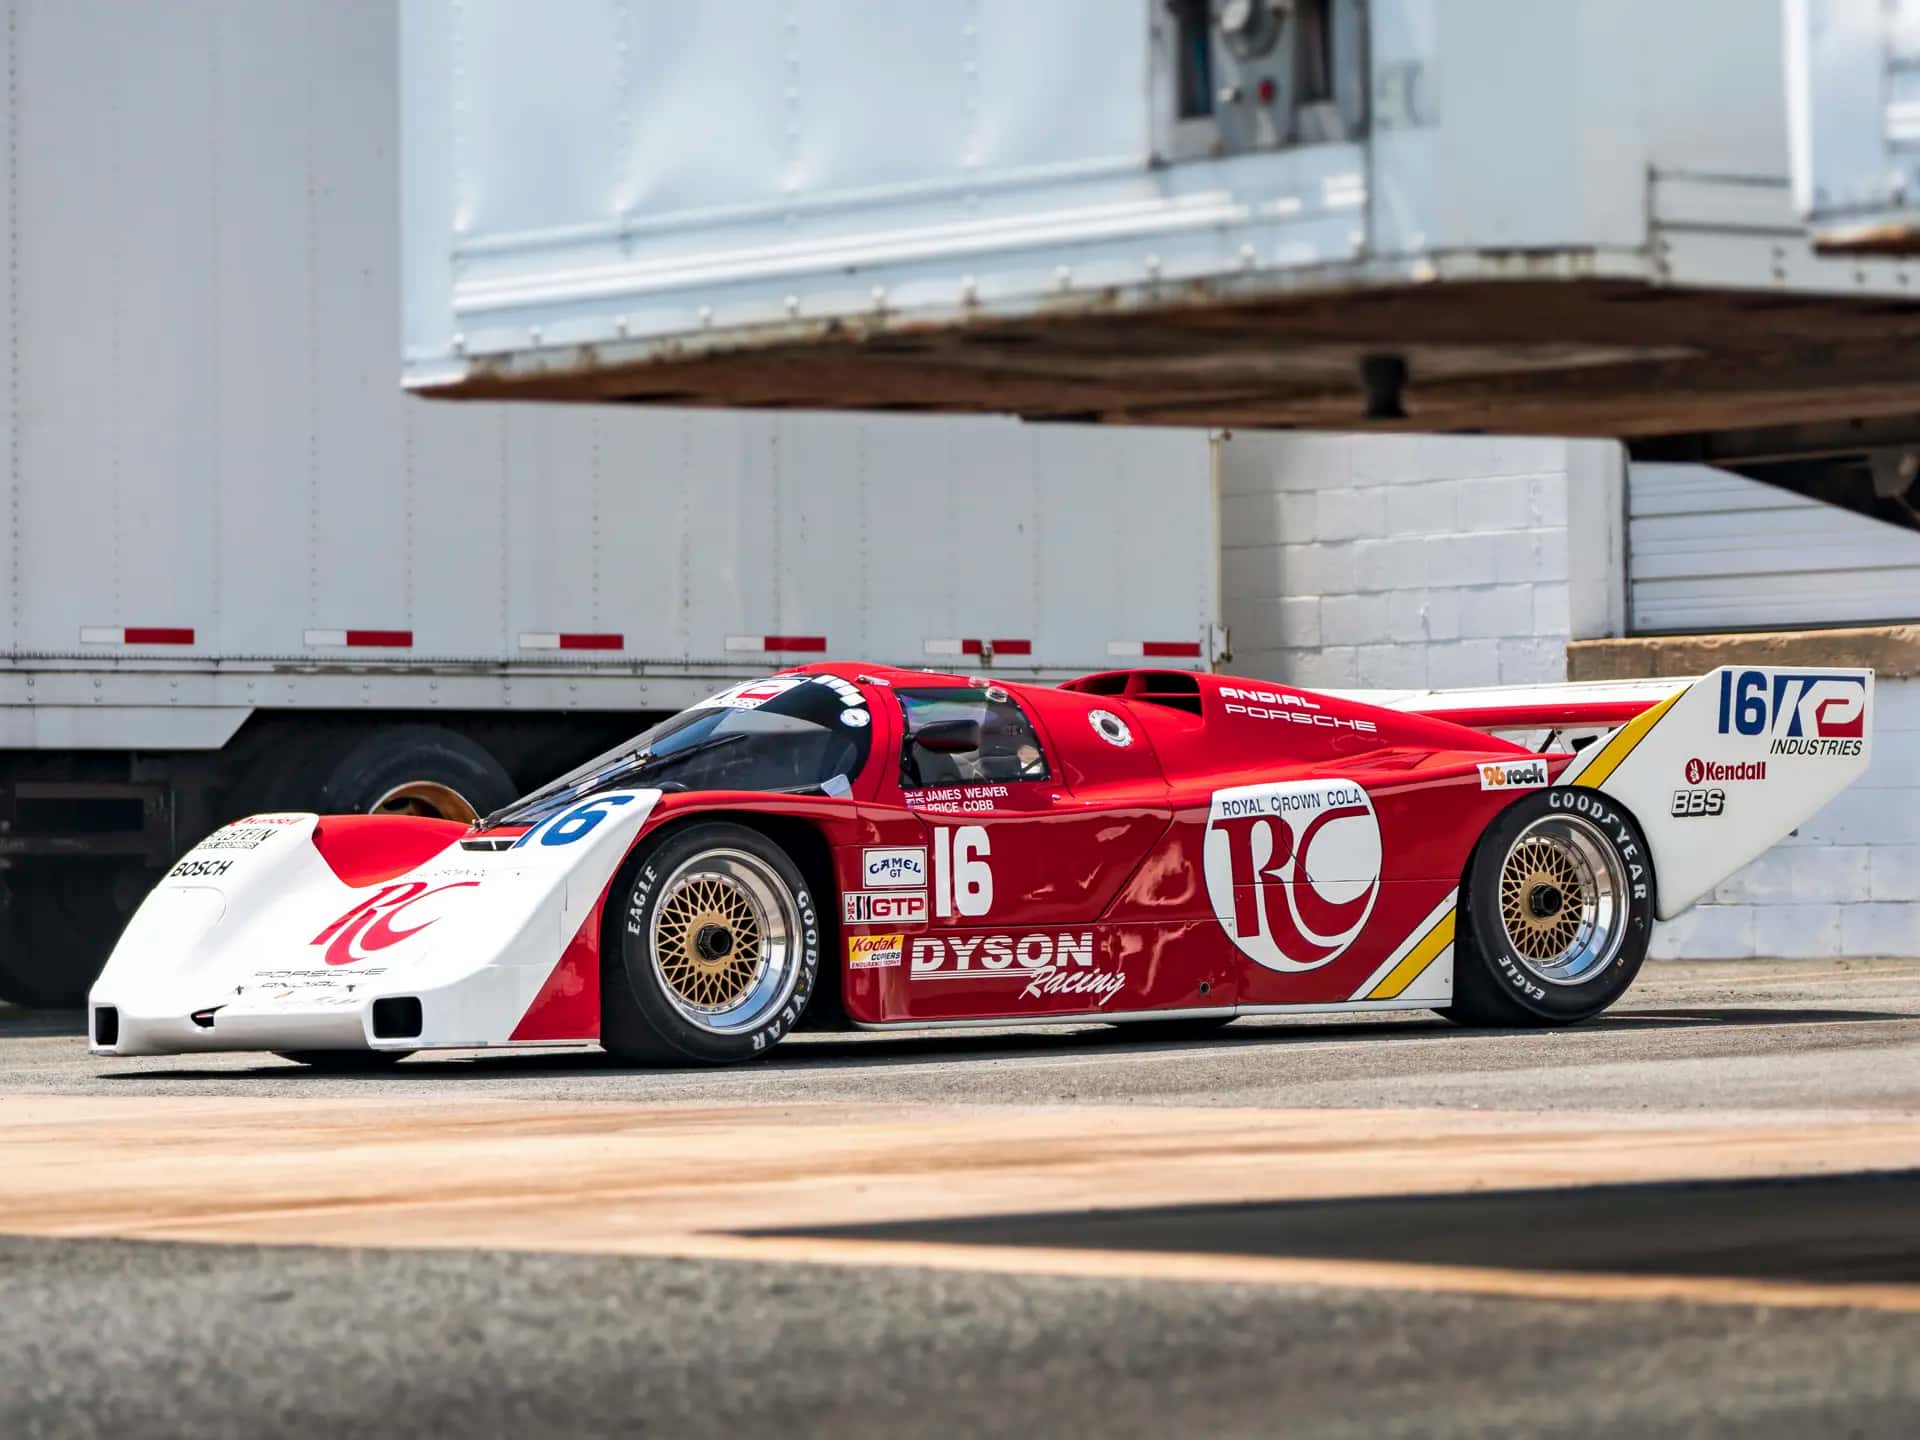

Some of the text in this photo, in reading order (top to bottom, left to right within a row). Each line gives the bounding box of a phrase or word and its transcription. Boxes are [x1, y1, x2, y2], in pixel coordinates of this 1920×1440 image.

[1219, 687, 1320, 709] ANDIAL
[1718, 671, 1767, 735] 16
[1225, 704, 1376, 732] PORSCHE
[1770, 739, 1863, 756] INDUSTRIES
[1483, 763, 1545, 786] 96 rock
[1706, 761, 1766, 781] Kendall
[926, 786, 1008, 802] JAMES WEAVER
[927, 799, 994, 813] PRICE COBB
[1222, 788, 1362, 816] ROYAL CROWN COLA
[1671, 789, 1725, 817] BBS
[513, 795, 636, 849] 16
[169, 859, 234, 877] BOSCH
[869, 858, 921, 875] CAMEL
[889, 868, 902, 878] GT
[934, 825, 994, 918] 16
[1211, 805, 1377, 963] RC
[627, 865, 657, 936] EAGLE
[872, 897, 925, 917] GTP
[308, 880, 482, 967] RC
[851, 937, 897, 953] Kodak
[910, 932, 1094, 971] DYSON
[1018, 965, 1126, 1006] Racing
[1498, 955, 1546, 1000] EAGLE
